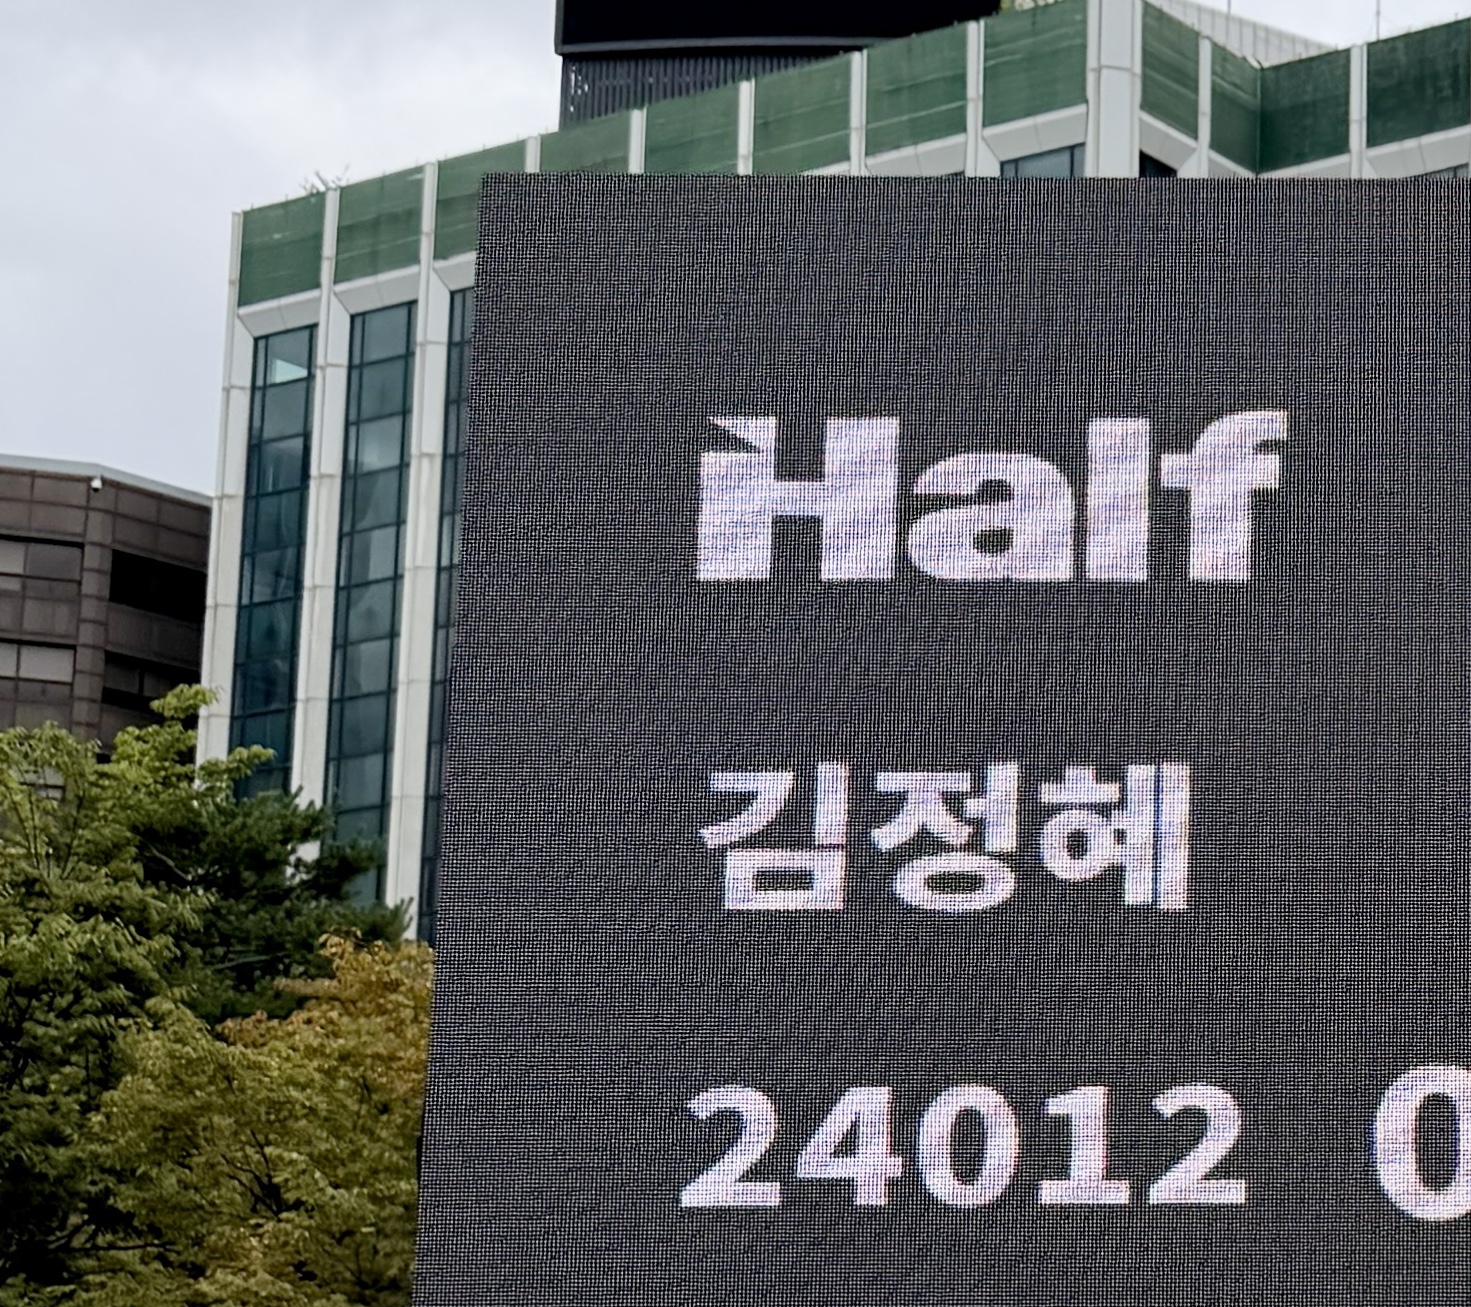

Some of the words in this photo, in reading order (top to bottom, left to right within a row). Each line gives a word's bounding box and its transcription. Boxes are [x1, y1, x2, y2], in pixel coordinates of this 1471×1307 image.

[696, 410, 1288, 582] Half
[698, 760, 1192, 912] 김정혜
[680, 1082, 1248, 1209] 24012
